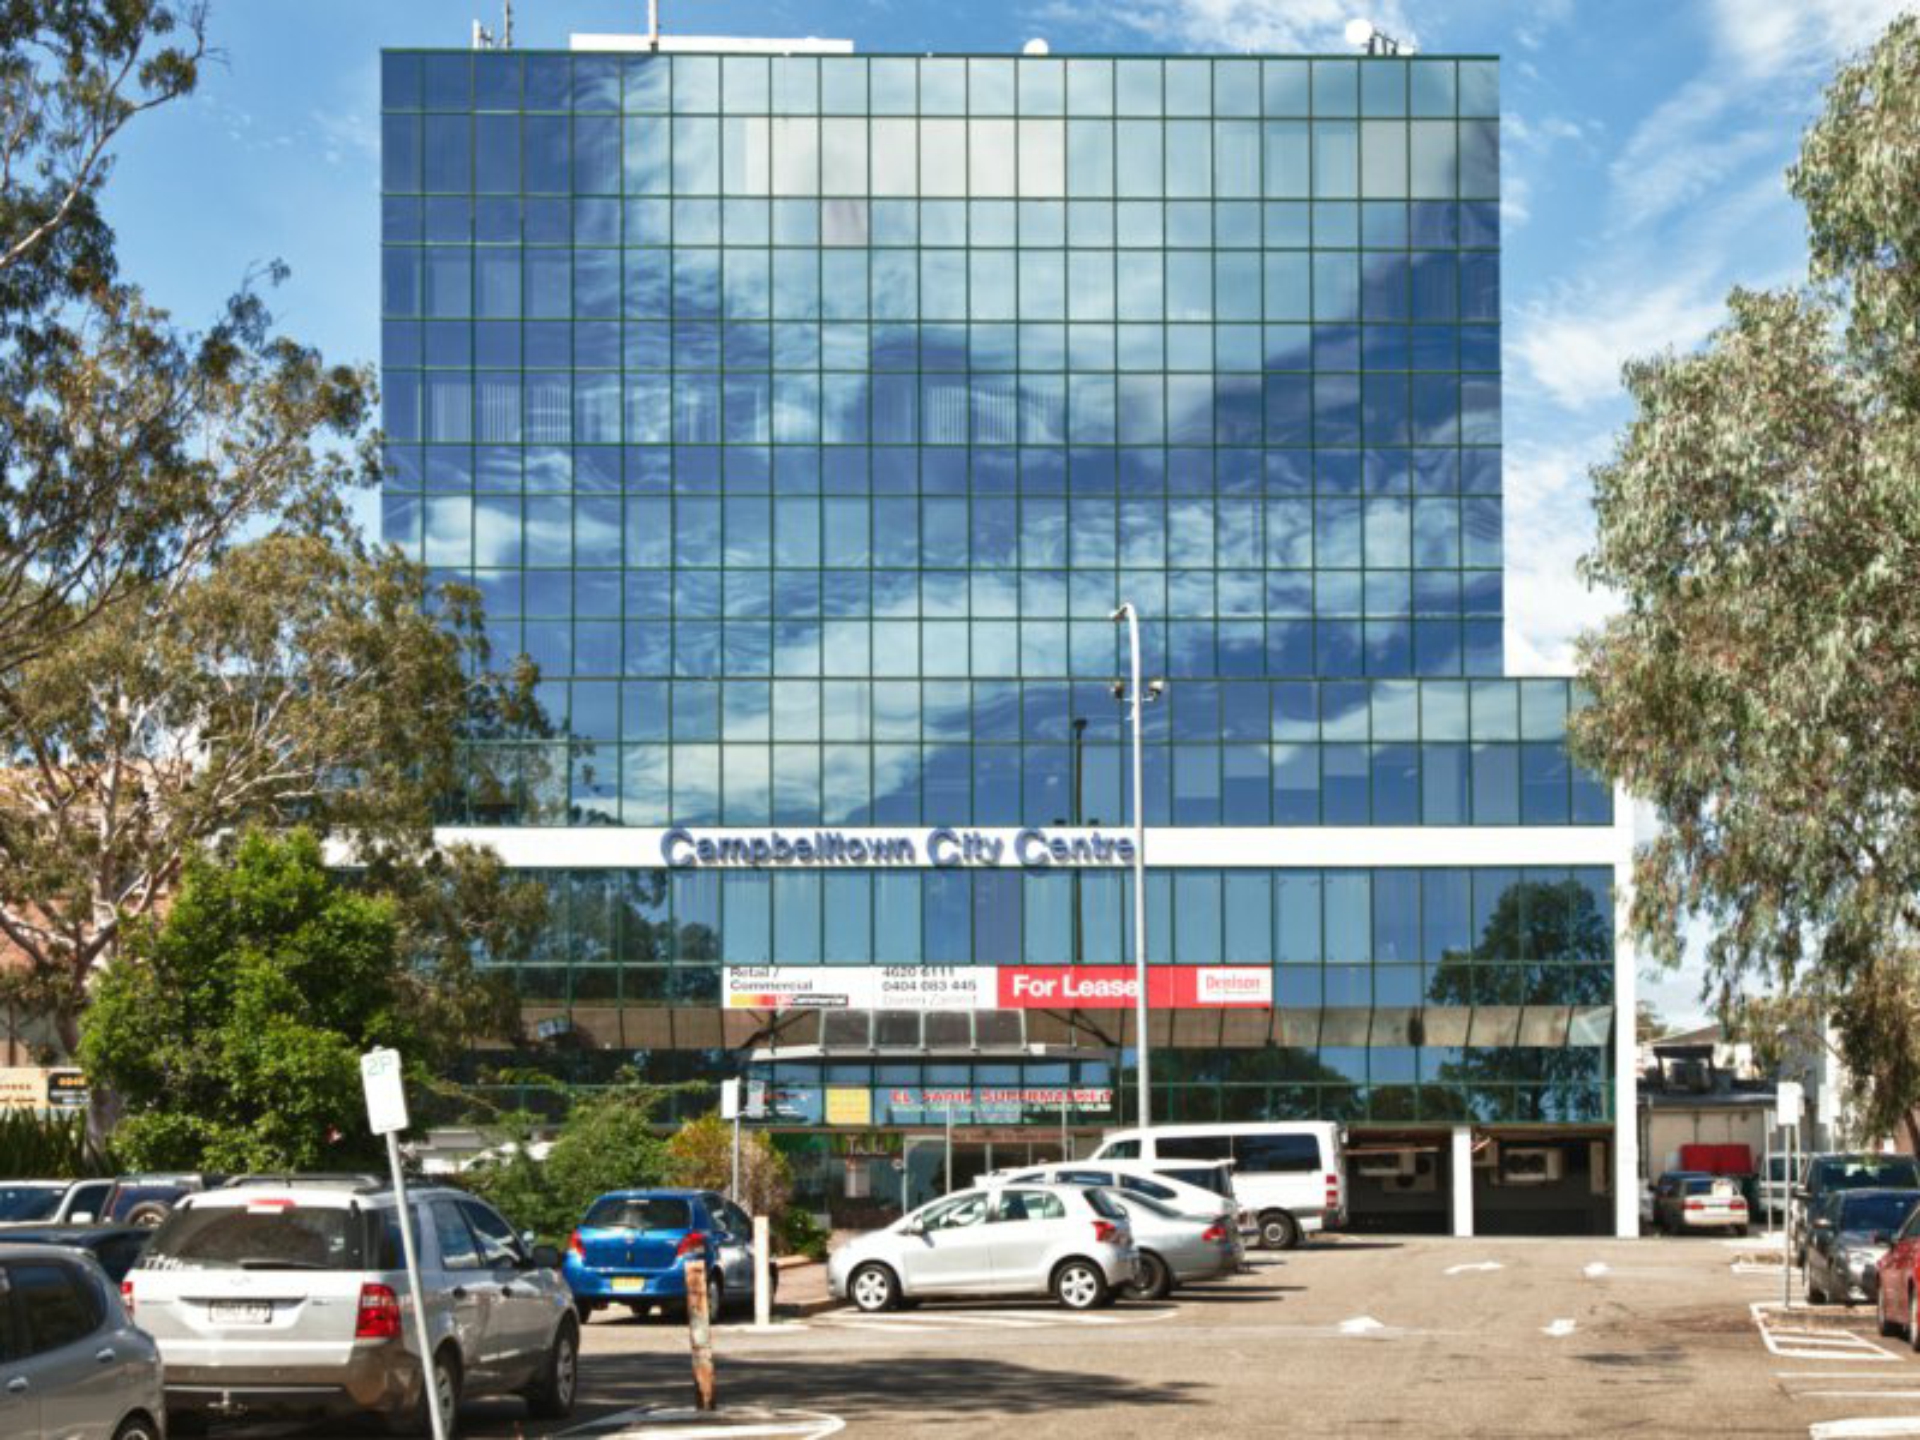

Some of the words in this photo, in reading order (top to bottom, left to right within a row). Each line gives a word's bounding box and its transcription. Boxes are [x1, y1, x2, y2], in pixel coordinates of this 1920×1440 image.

[661, 827, 917, 869] Campbelltown
[927, 828, 1005, 867] City
[1014, 828, 1136, 867] Centre
[730, 966, 769, 978] Retail
[730, 979, 813, 991] Commercial
[882, 980, 917, 992] 0404
[1013, 974, 1057, 997] For
[1062, 974, 1138, 998] Lease
[1205, 973, 1260, 989] Denison
[366, 1055, 393, 1077] 2P
